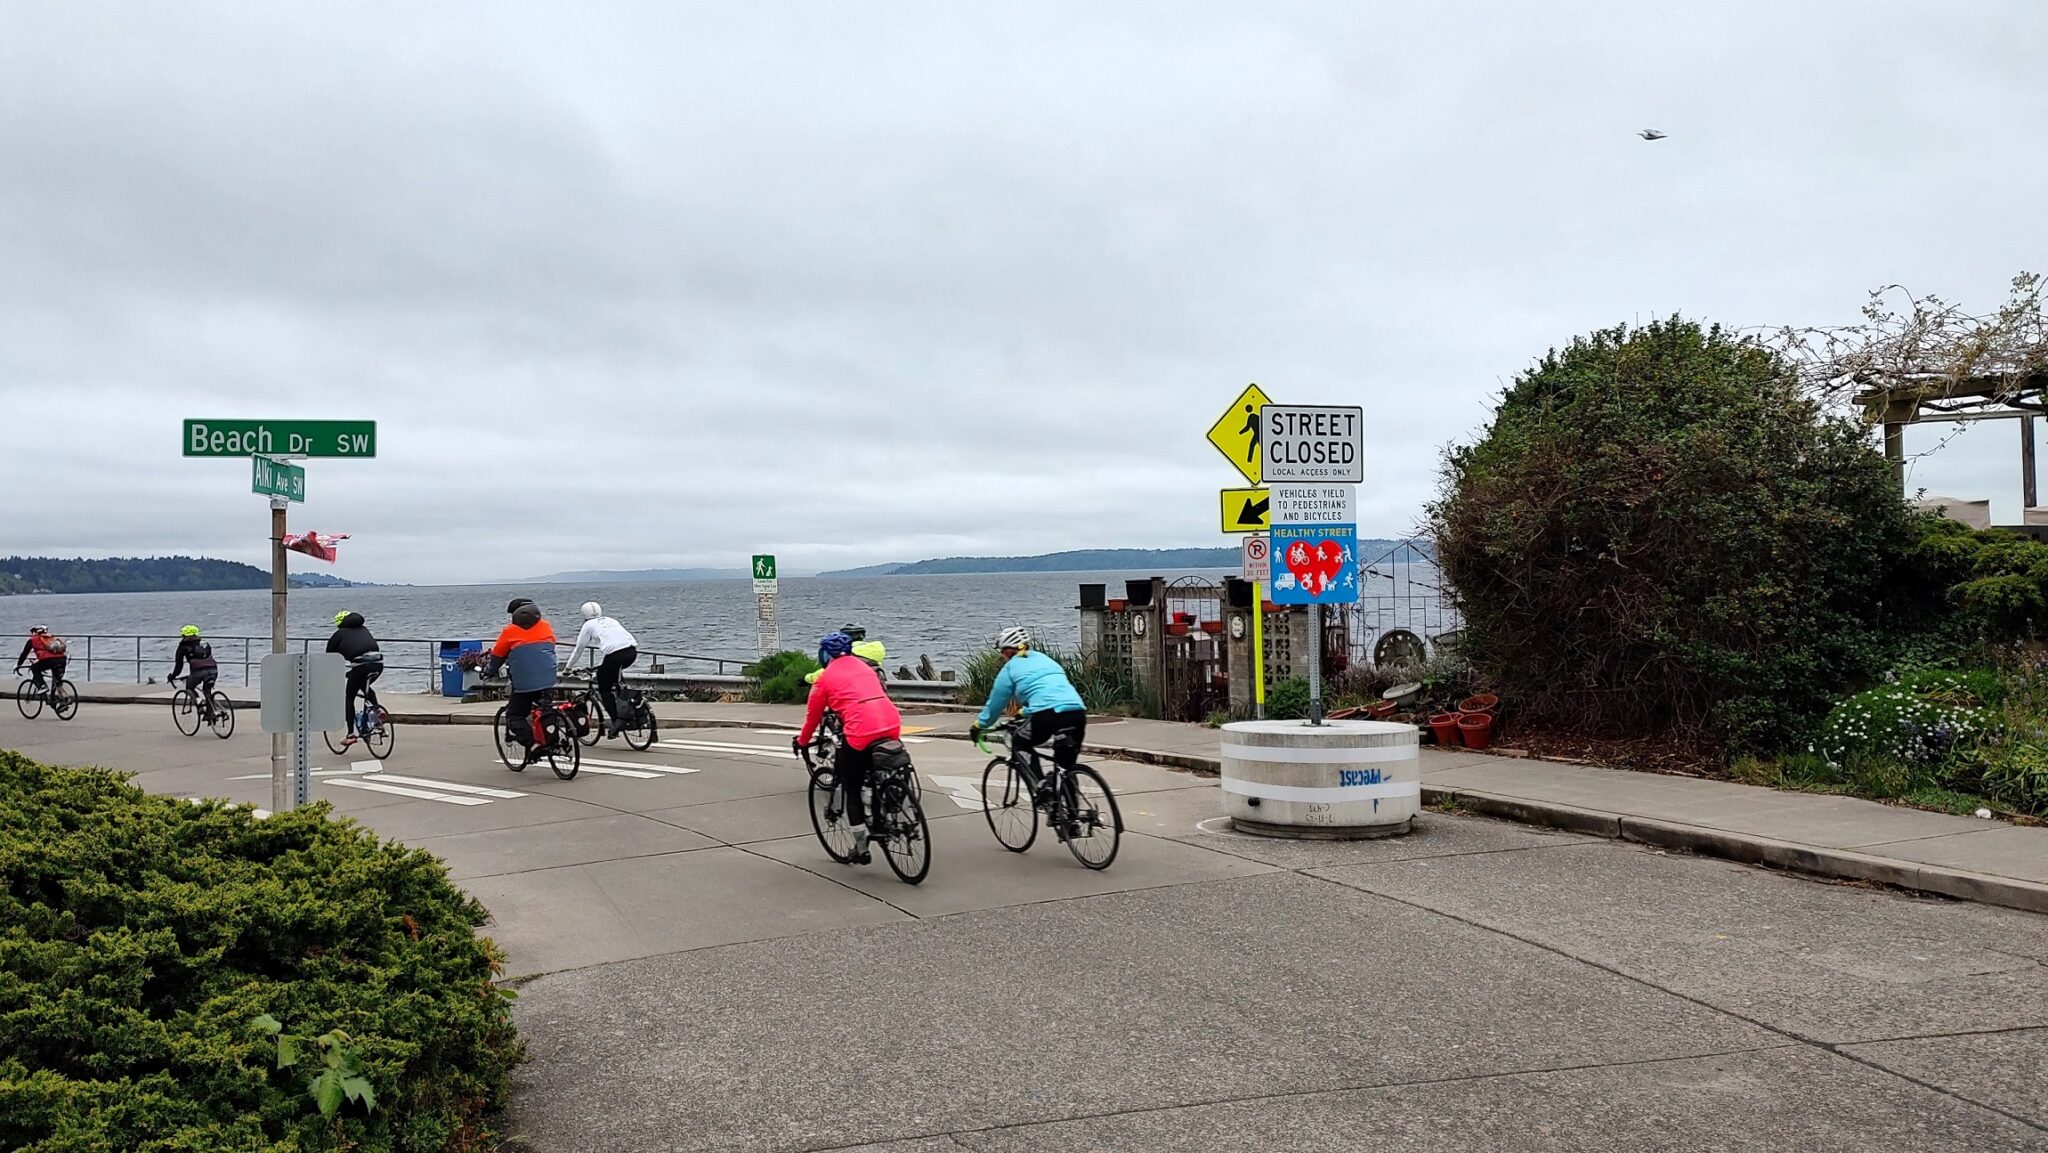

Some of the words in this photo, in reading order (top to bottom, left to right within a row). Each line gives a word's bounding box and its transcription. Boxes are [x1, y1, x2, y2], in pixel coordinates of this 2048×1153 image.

[1271, 412, 1356, 437] STREET
[191, 424, 272, 453] Beach
[290, 433, 313, 453] Dr
[337, 434, 369, 453] SW
[1270, 440, 1354, 464] CLOSED
[255, 458, 272, 489] Alki
[276, 474, 288, 492] Ave
[293, 475, 303, 495] SW
[1272, 468, 1296, 476] LOCAL
[1301, 468, 1328, 476] ACCESS
[1332, 468, 1351, 476] ONLY
[1279, 489, 1317, 498] VEHICLES
[1322, 489, 1345, 498] YIELD
[1278, 500, 1288, 509] TO
[1292, 500, 1347, 509] PEDESTRIANS
[1283, 512, 1300, 521] AND
[1304, 512, 1342, 521] BICYCLES
[1274, 528, 1316, 538] HEALTHY
[1318, 527, 1353, 537] STREET
